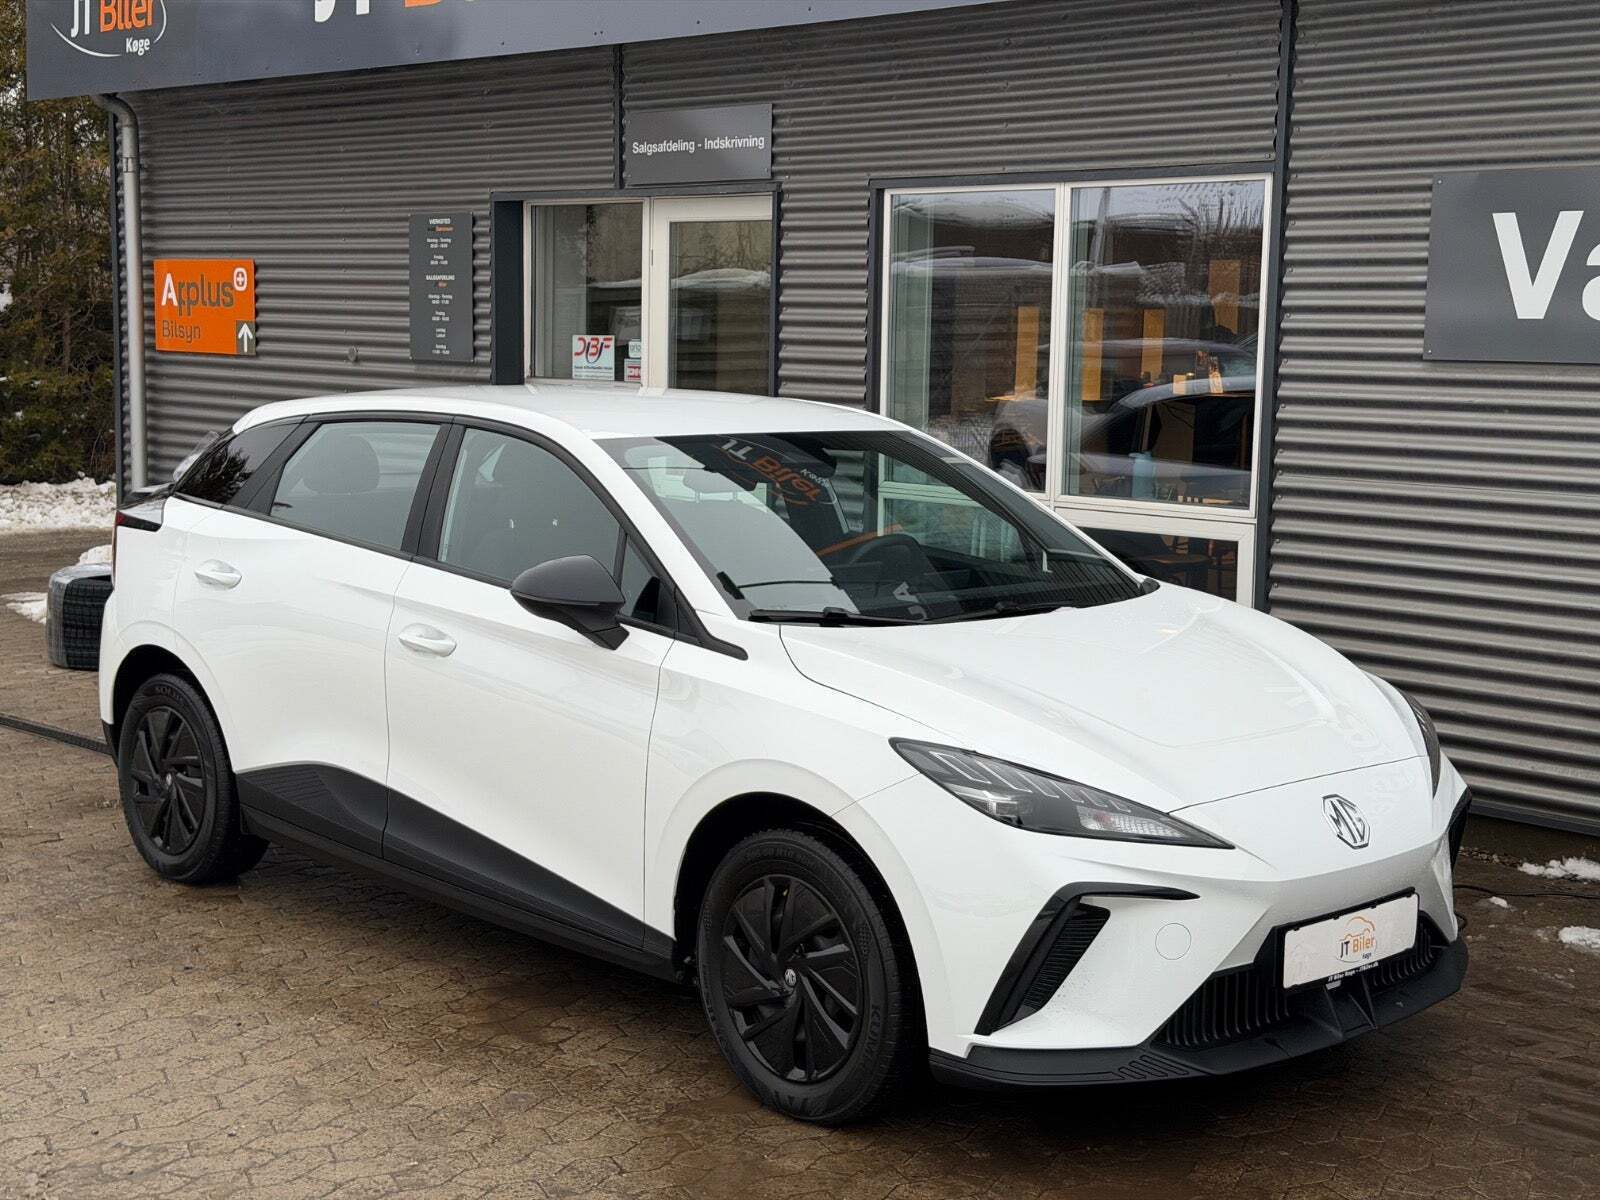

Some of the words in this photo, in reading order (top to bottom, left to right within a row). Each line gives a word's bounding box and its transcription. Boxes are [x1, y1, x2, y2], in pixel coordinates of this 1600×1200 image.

[126, 38, 150, 56] Køge
[632, 140, 695, 155] Salgsafdeling
[704, 135, 765, 150] Indskrivning
[1492, 210, 1600, 320] V
[162, 320, 201, 344] Bilsyn
[1328, 798, 1367, 844] MG
[1340, 940, 1351, 959] JT
